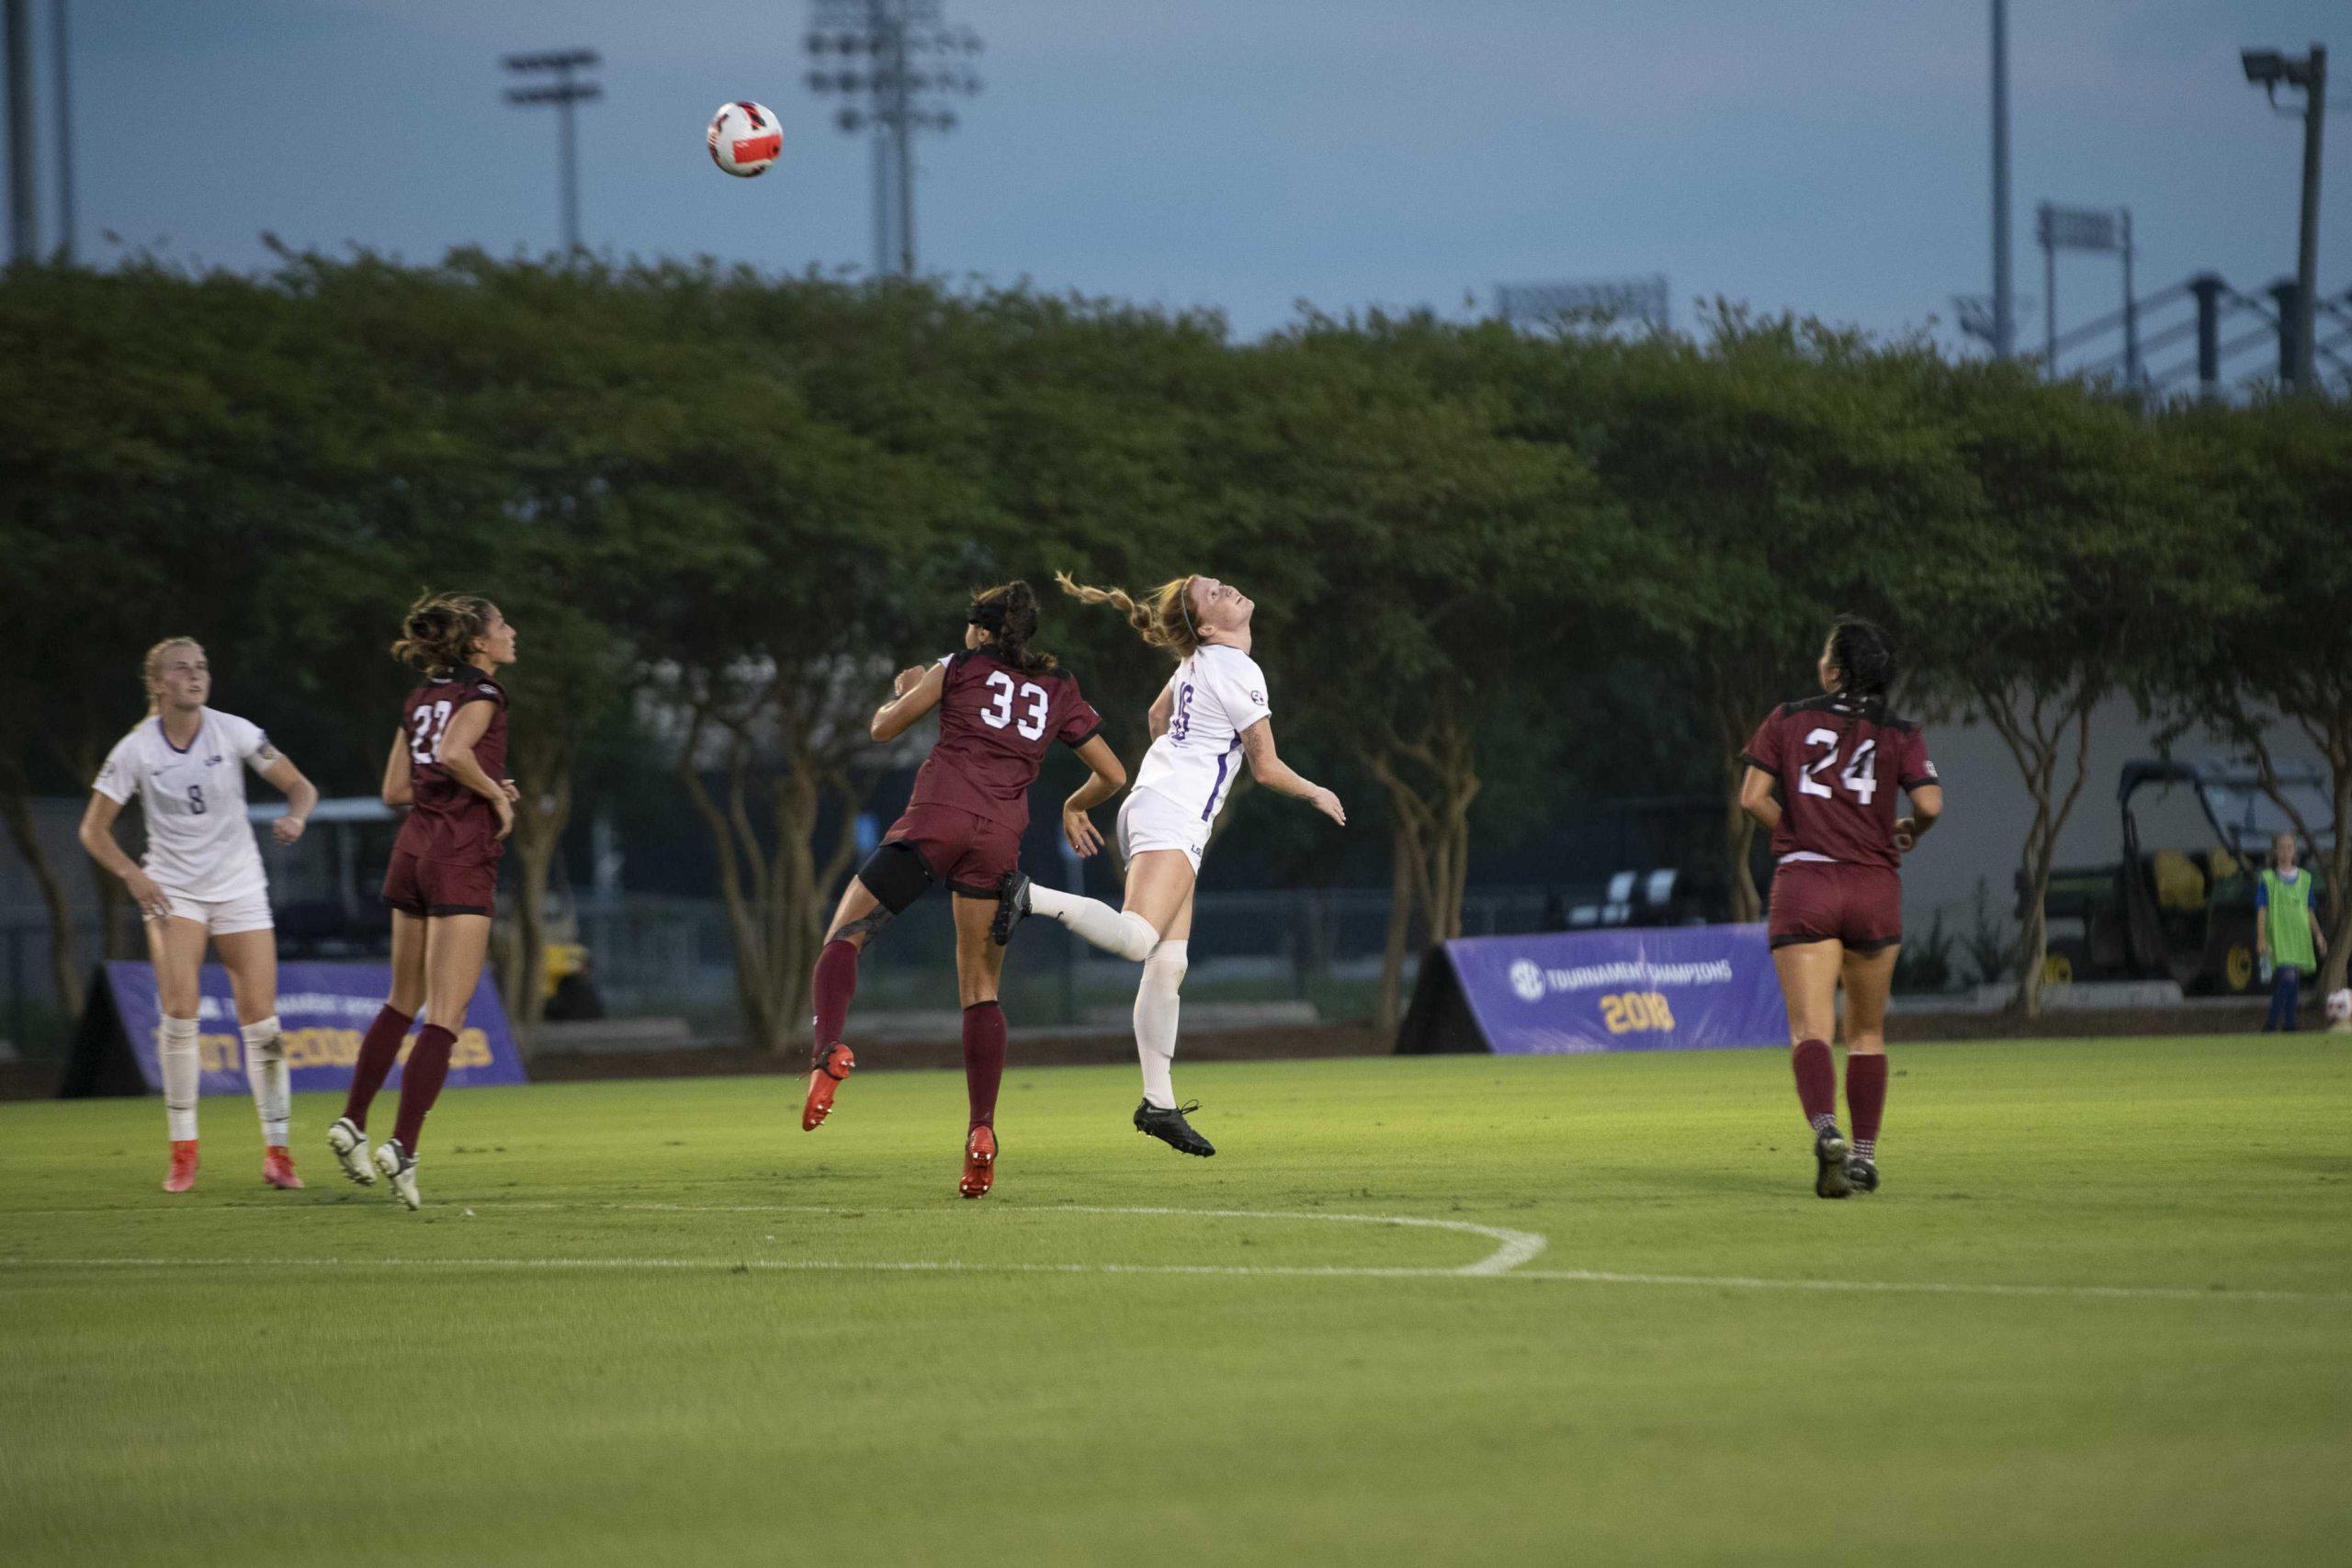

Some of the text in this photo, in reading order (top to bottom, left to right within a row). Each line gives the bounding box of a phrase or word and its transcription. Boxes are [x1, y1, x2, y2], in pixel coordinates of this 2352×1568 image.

[980, 670, 1048, 741] 33
[1798, 728, 1877, 805] 24
[187, 784, 206, 815] 8
[1546, 961, 1646, 991] TOURNAMENT
[1646, 959, 1733, 986] CHAMPIONS
[1600, 991, 1676, 1033] 2018
